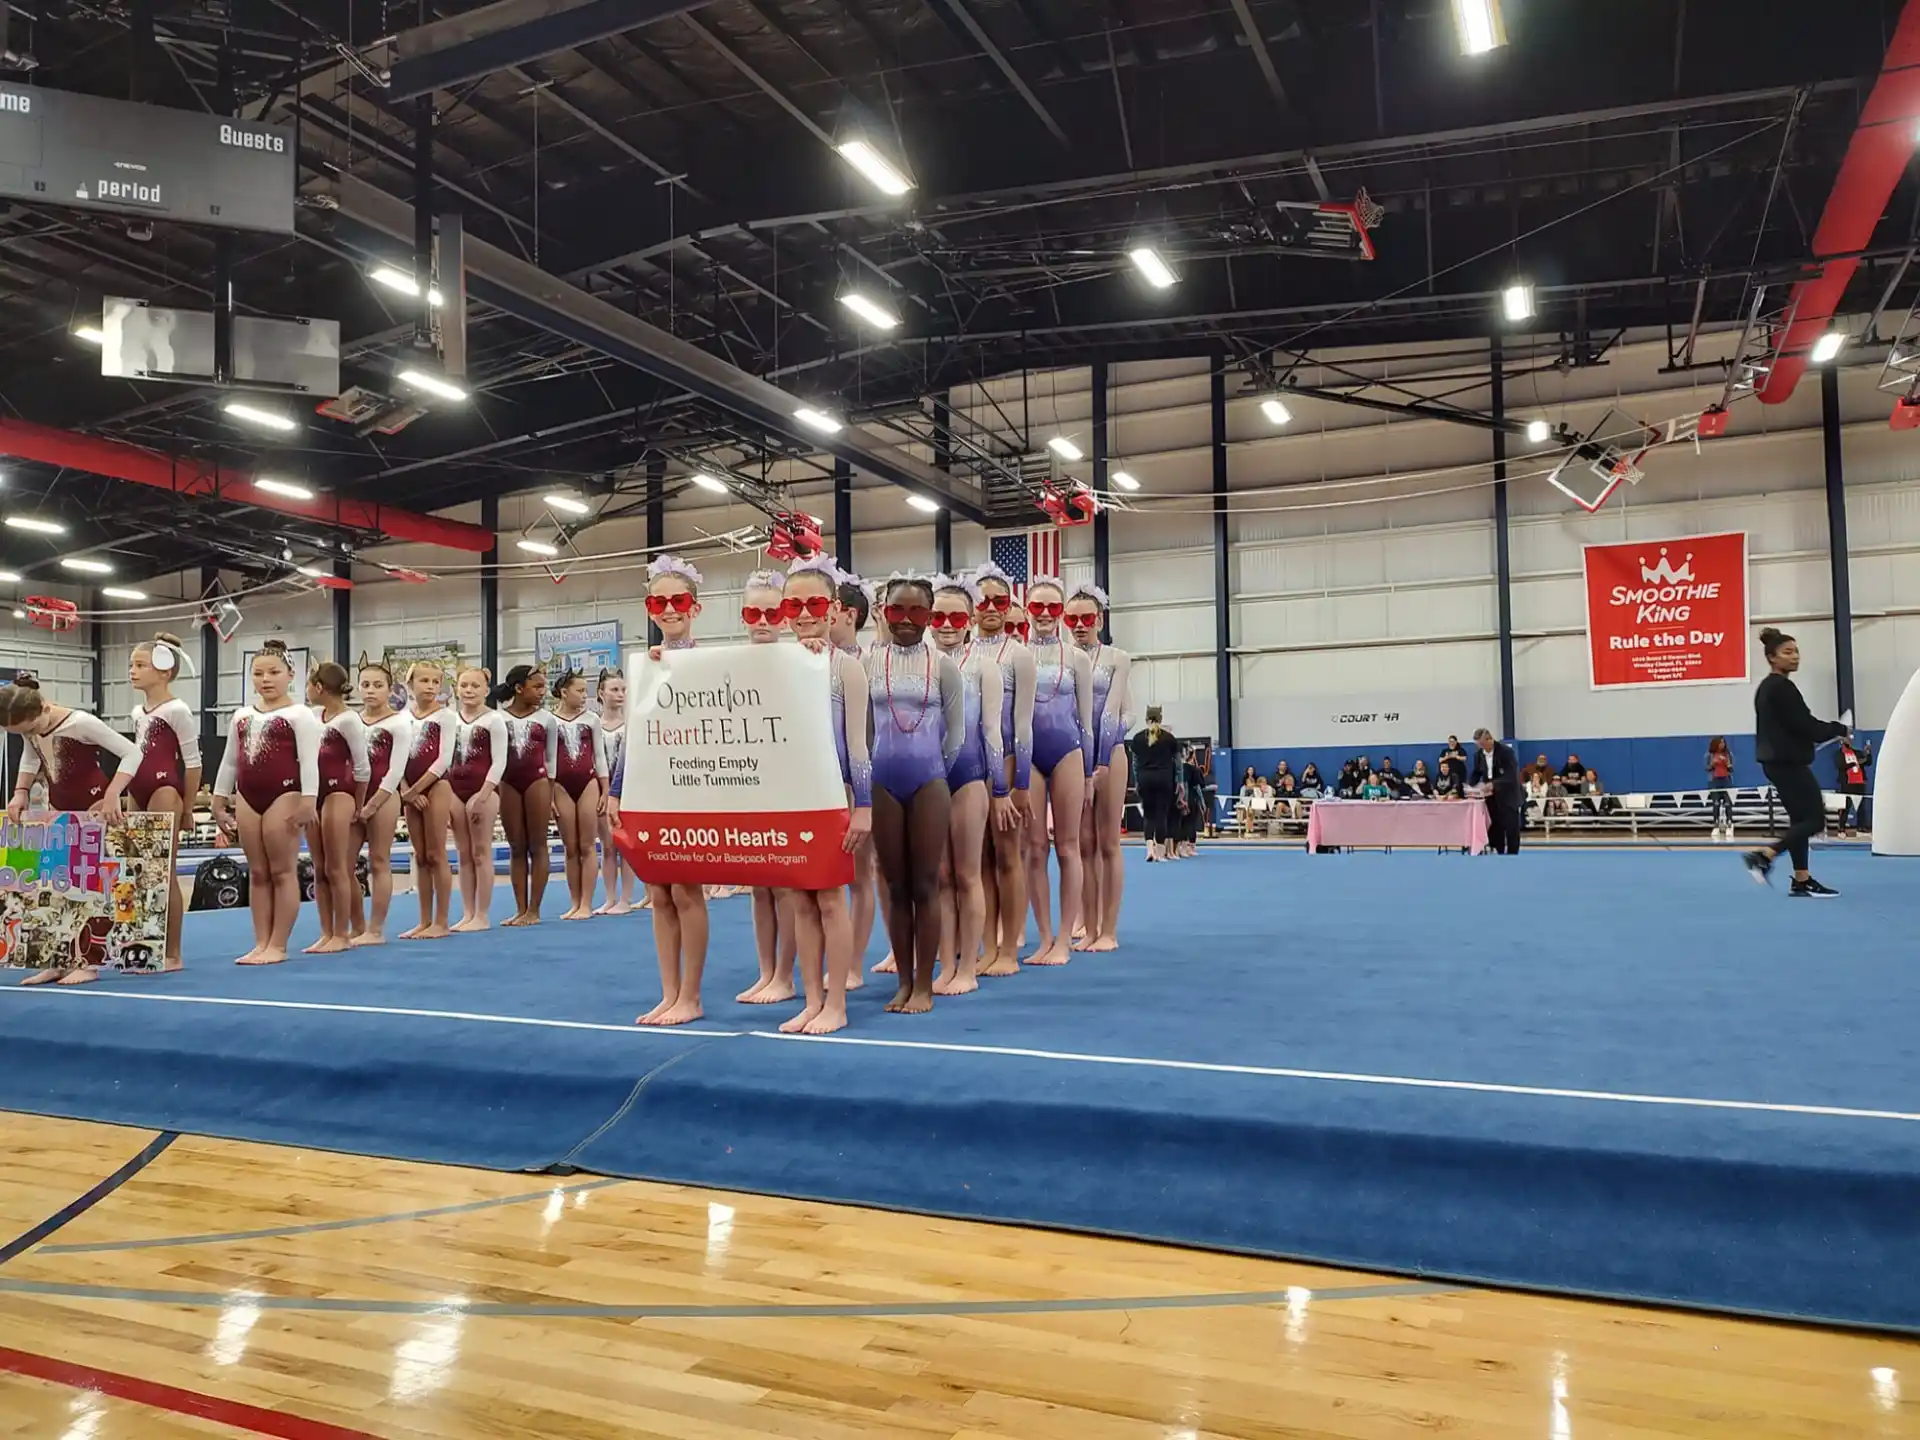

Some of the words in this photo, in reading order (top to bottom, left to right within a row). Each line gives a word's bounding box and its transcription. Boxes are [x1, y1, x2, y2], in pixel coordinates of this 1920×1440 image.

[220, 124, 284, 152] Guests
[98, 179, 160, 203] period
[1609, 583, 1721, 605] SMOOTHIE
[1610, 635, 1650, 650] Rule
[1653, 632, 1685, 646] the
[1690, 630, 1724, 648] Day
[657, 671, 761, 715] Operation
[1340, 714, 1378, 723] COURT
[669, 757, 716, 772] Feeding
[719, 756, 758, 771] Empty
[672, 774, 701, 787] Little
[703, 773, 760, 786] Tummies
[659, 828, 720, 850] 20,000
[725, 829, 788, 846] Hearts
[648, 851, 669, 862] Food
[670, 851, 692, 863] Drive
[693, 852, 705, 863] for
[706, 853, 722, 863] Our
[724, 853, 767, 865] Backpack
[768, 854, 808, 866] Program
